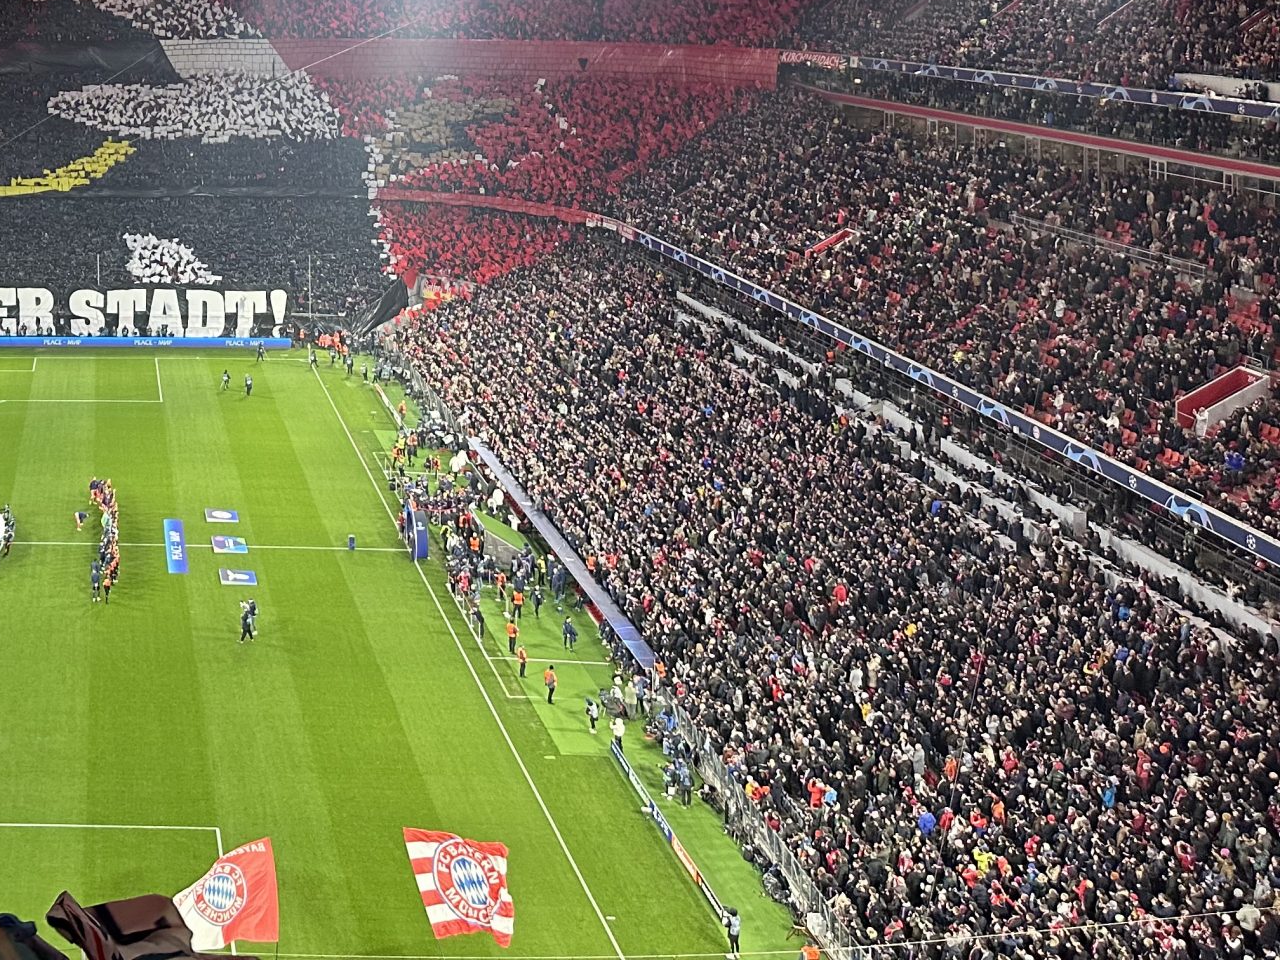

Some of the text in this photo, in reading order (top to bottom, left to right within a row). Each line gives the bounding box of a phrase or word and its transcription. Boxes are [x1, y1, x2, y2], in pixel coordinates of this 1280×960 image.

[69, 288, 288, 338] STADT!
[437, 843, 500, 885] FC BAYERN
